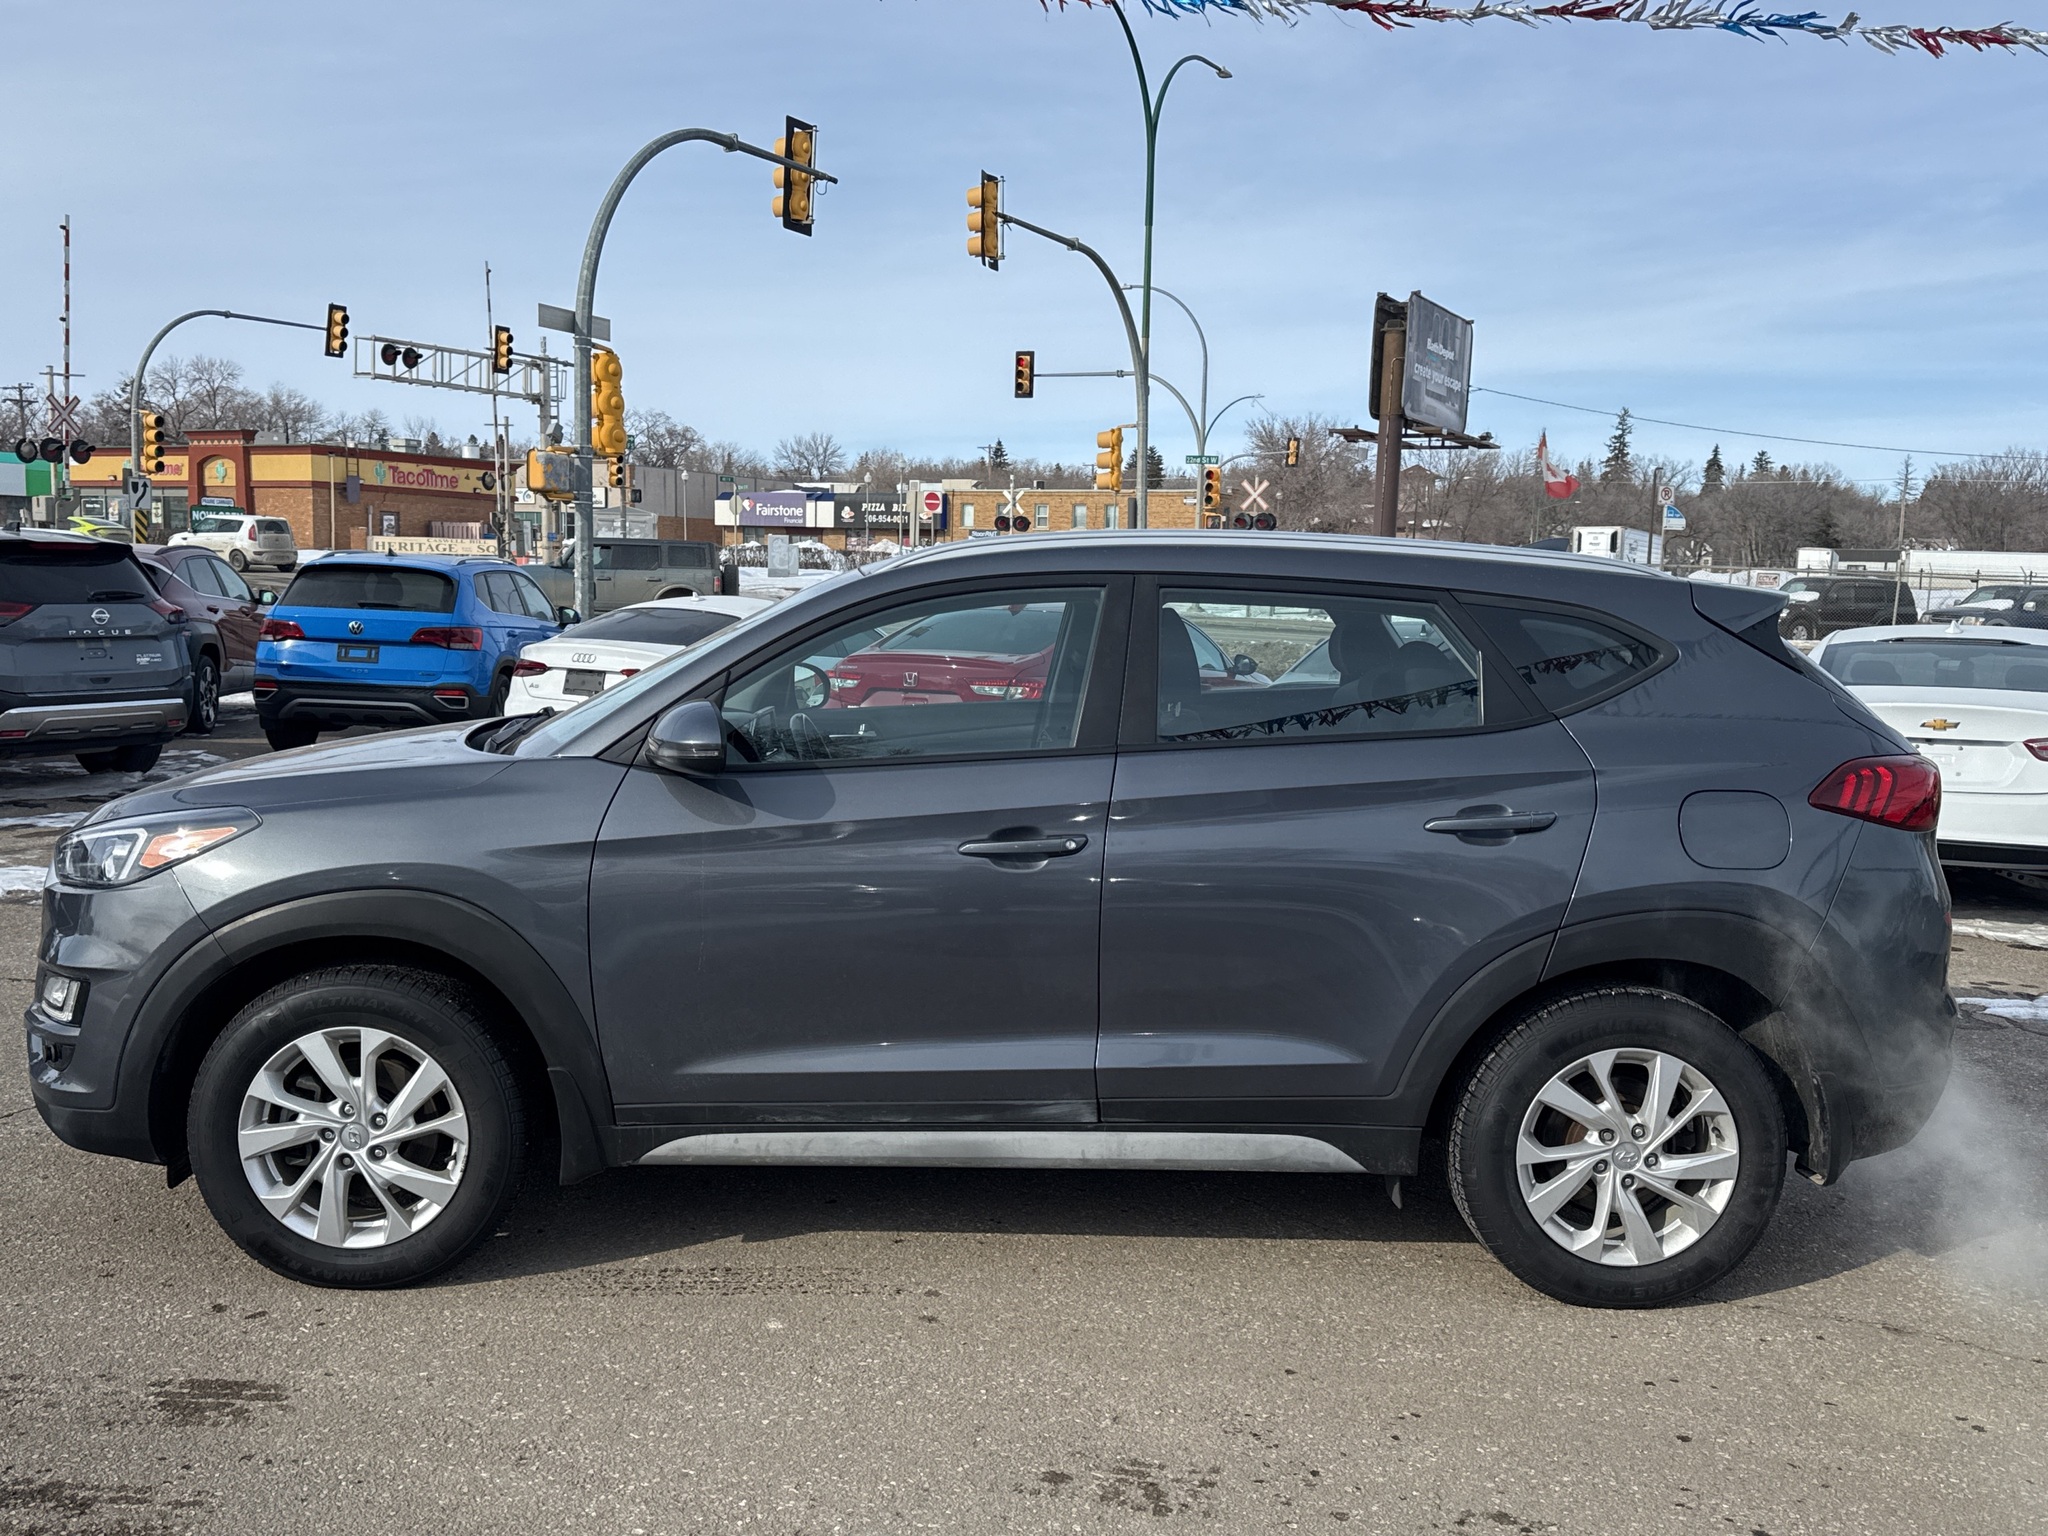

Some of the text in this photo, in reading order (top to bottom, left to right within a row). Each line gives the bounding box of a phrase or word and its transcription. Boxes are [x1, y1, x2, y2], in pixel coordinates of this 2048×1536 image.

[1414, 363, 1462, 393] create your escape
[1202, 456, 1210, 464] St
[1210, 456, 1218, 464] W
[388, 465, 458, 489] TacoTime
[756, 504, 804, 517] Fairstone
[861, 503, 886, 511] PIZZA
[375, 541, 458, 553] HERITAGE
